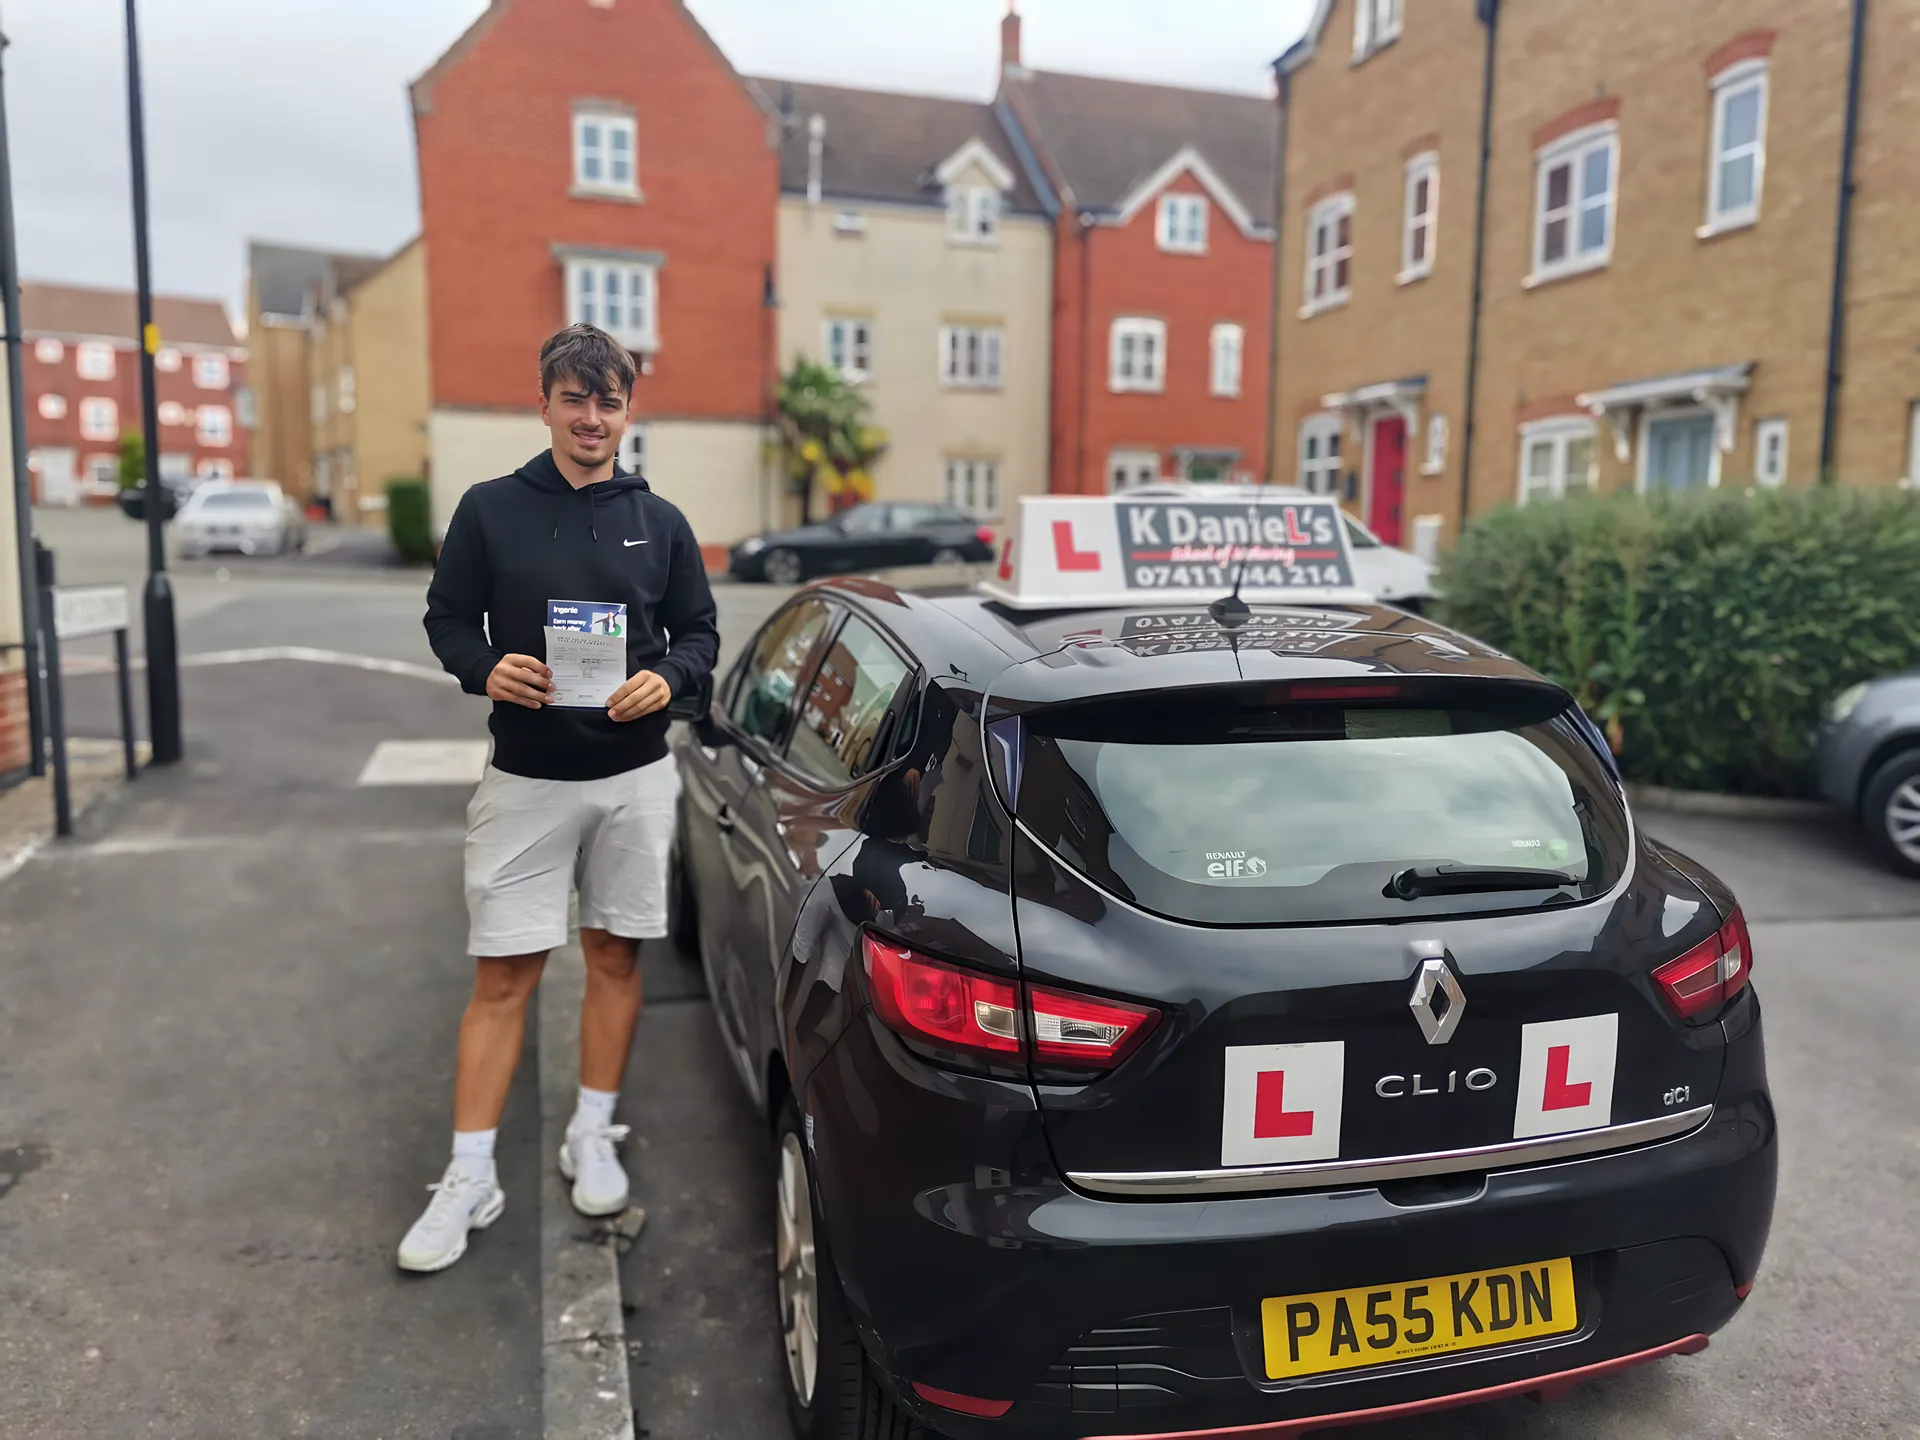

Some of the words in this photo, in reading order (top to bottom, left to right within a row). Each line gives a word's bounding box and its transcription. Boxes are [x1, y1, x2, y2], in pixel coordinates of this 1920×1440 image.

[1129, 506, 1162, 545] K
[1052, 521, 1102, 572] L
[1135, 565, 1224, 587] 07411
[1288, 564, 1341, 585] 214
[1205, 850, 1247, 860] RENAULT
[1207, 860, 1244, 877] elf
[1375, 1068, 1498, 1098] CLIO
[1541, 1045, 1592, 1111] L
[1253, 1070, 1314, 1139] L
[1286, 1286, 1434, 1362] PA55
[1450, 1267, 1553, 1338] KDN
